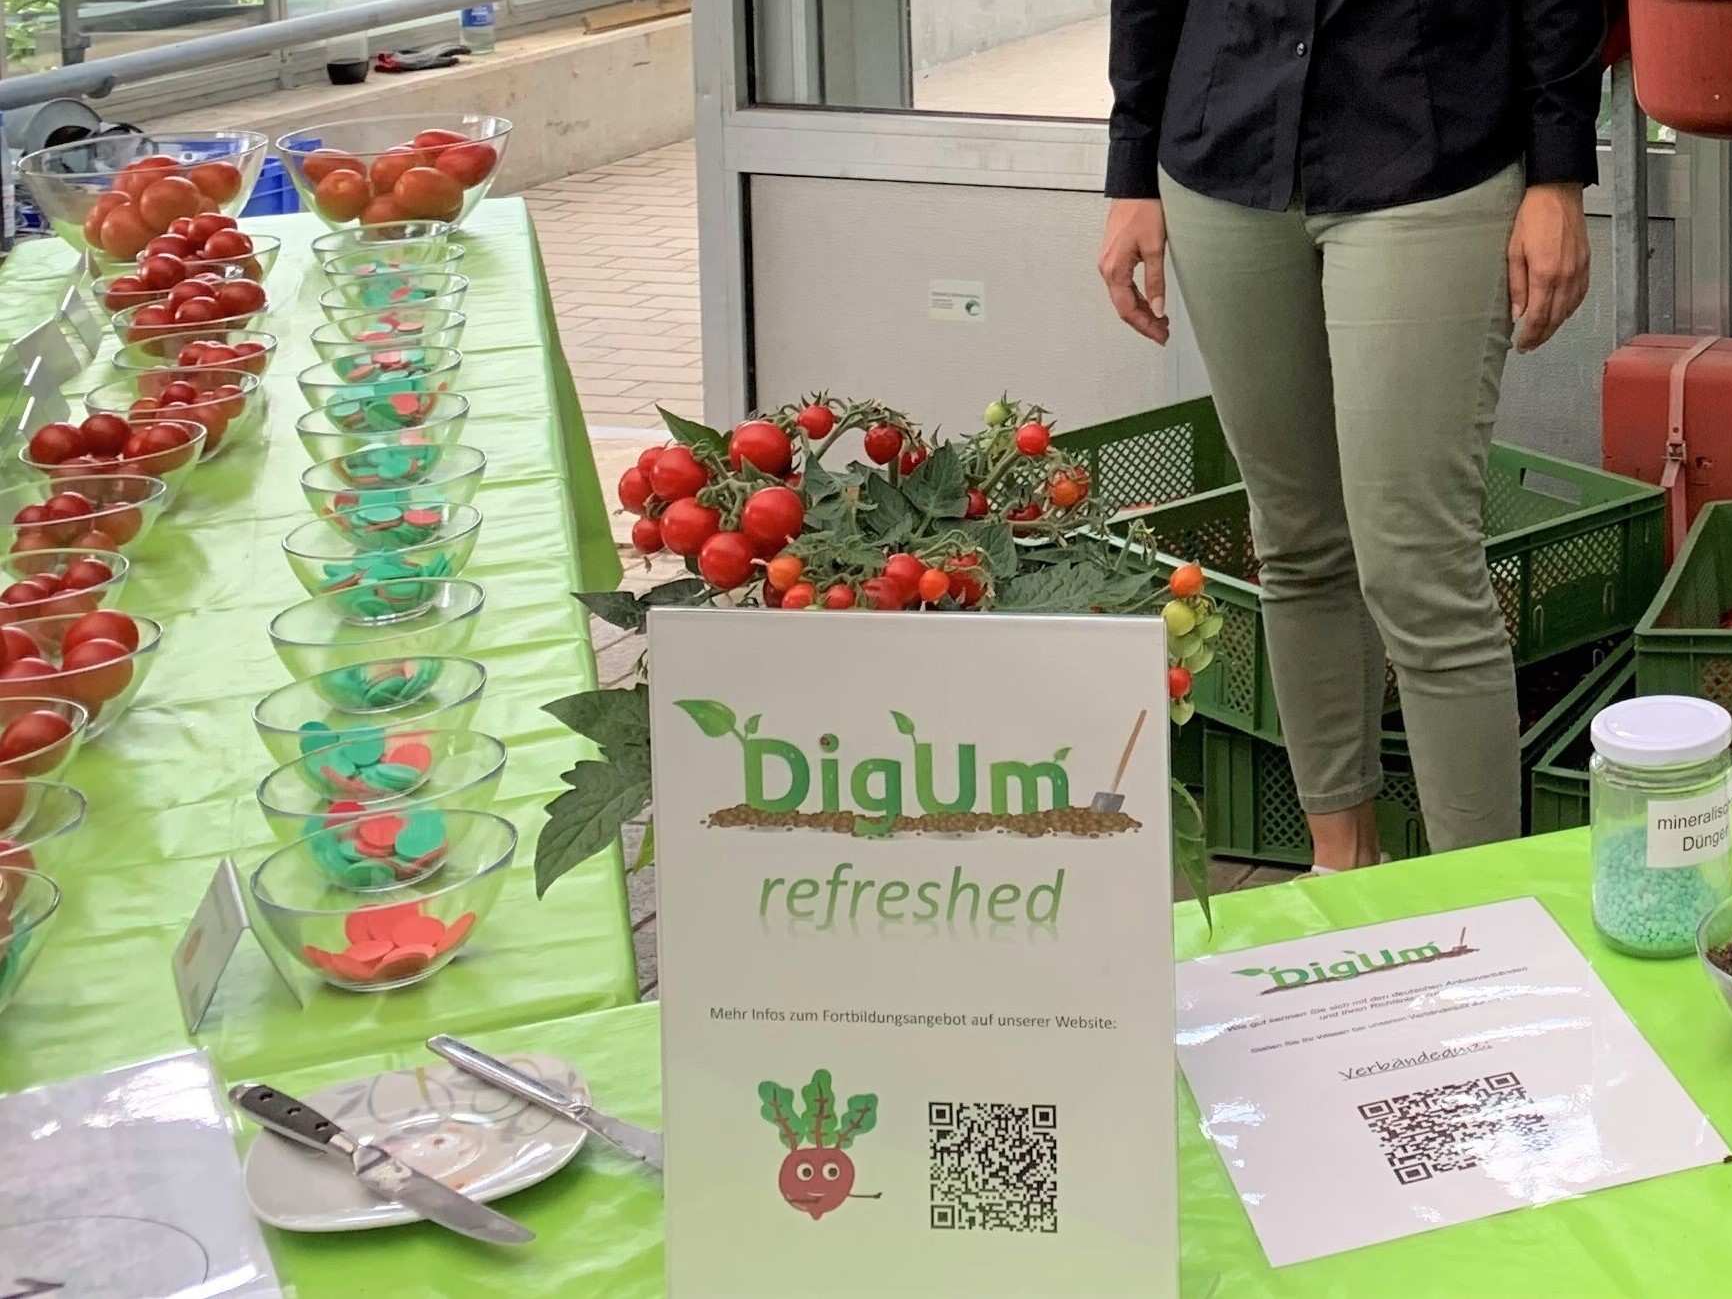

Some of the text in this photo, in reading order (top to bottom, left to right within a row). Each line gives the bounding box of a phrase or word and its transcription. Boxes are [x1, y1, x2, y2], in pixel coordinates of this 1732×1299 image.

[742, 732, 1070, 837] DigUm
[759, 862, 1066, 930] refreshed
[1270, 945, 1442, 990] DigUm
[1392, 983, 1443, 998] deutschen
[710, 1006, 1117, 1030] Mehr Infos zum Fortbildungsangebot auf unserer Website:
